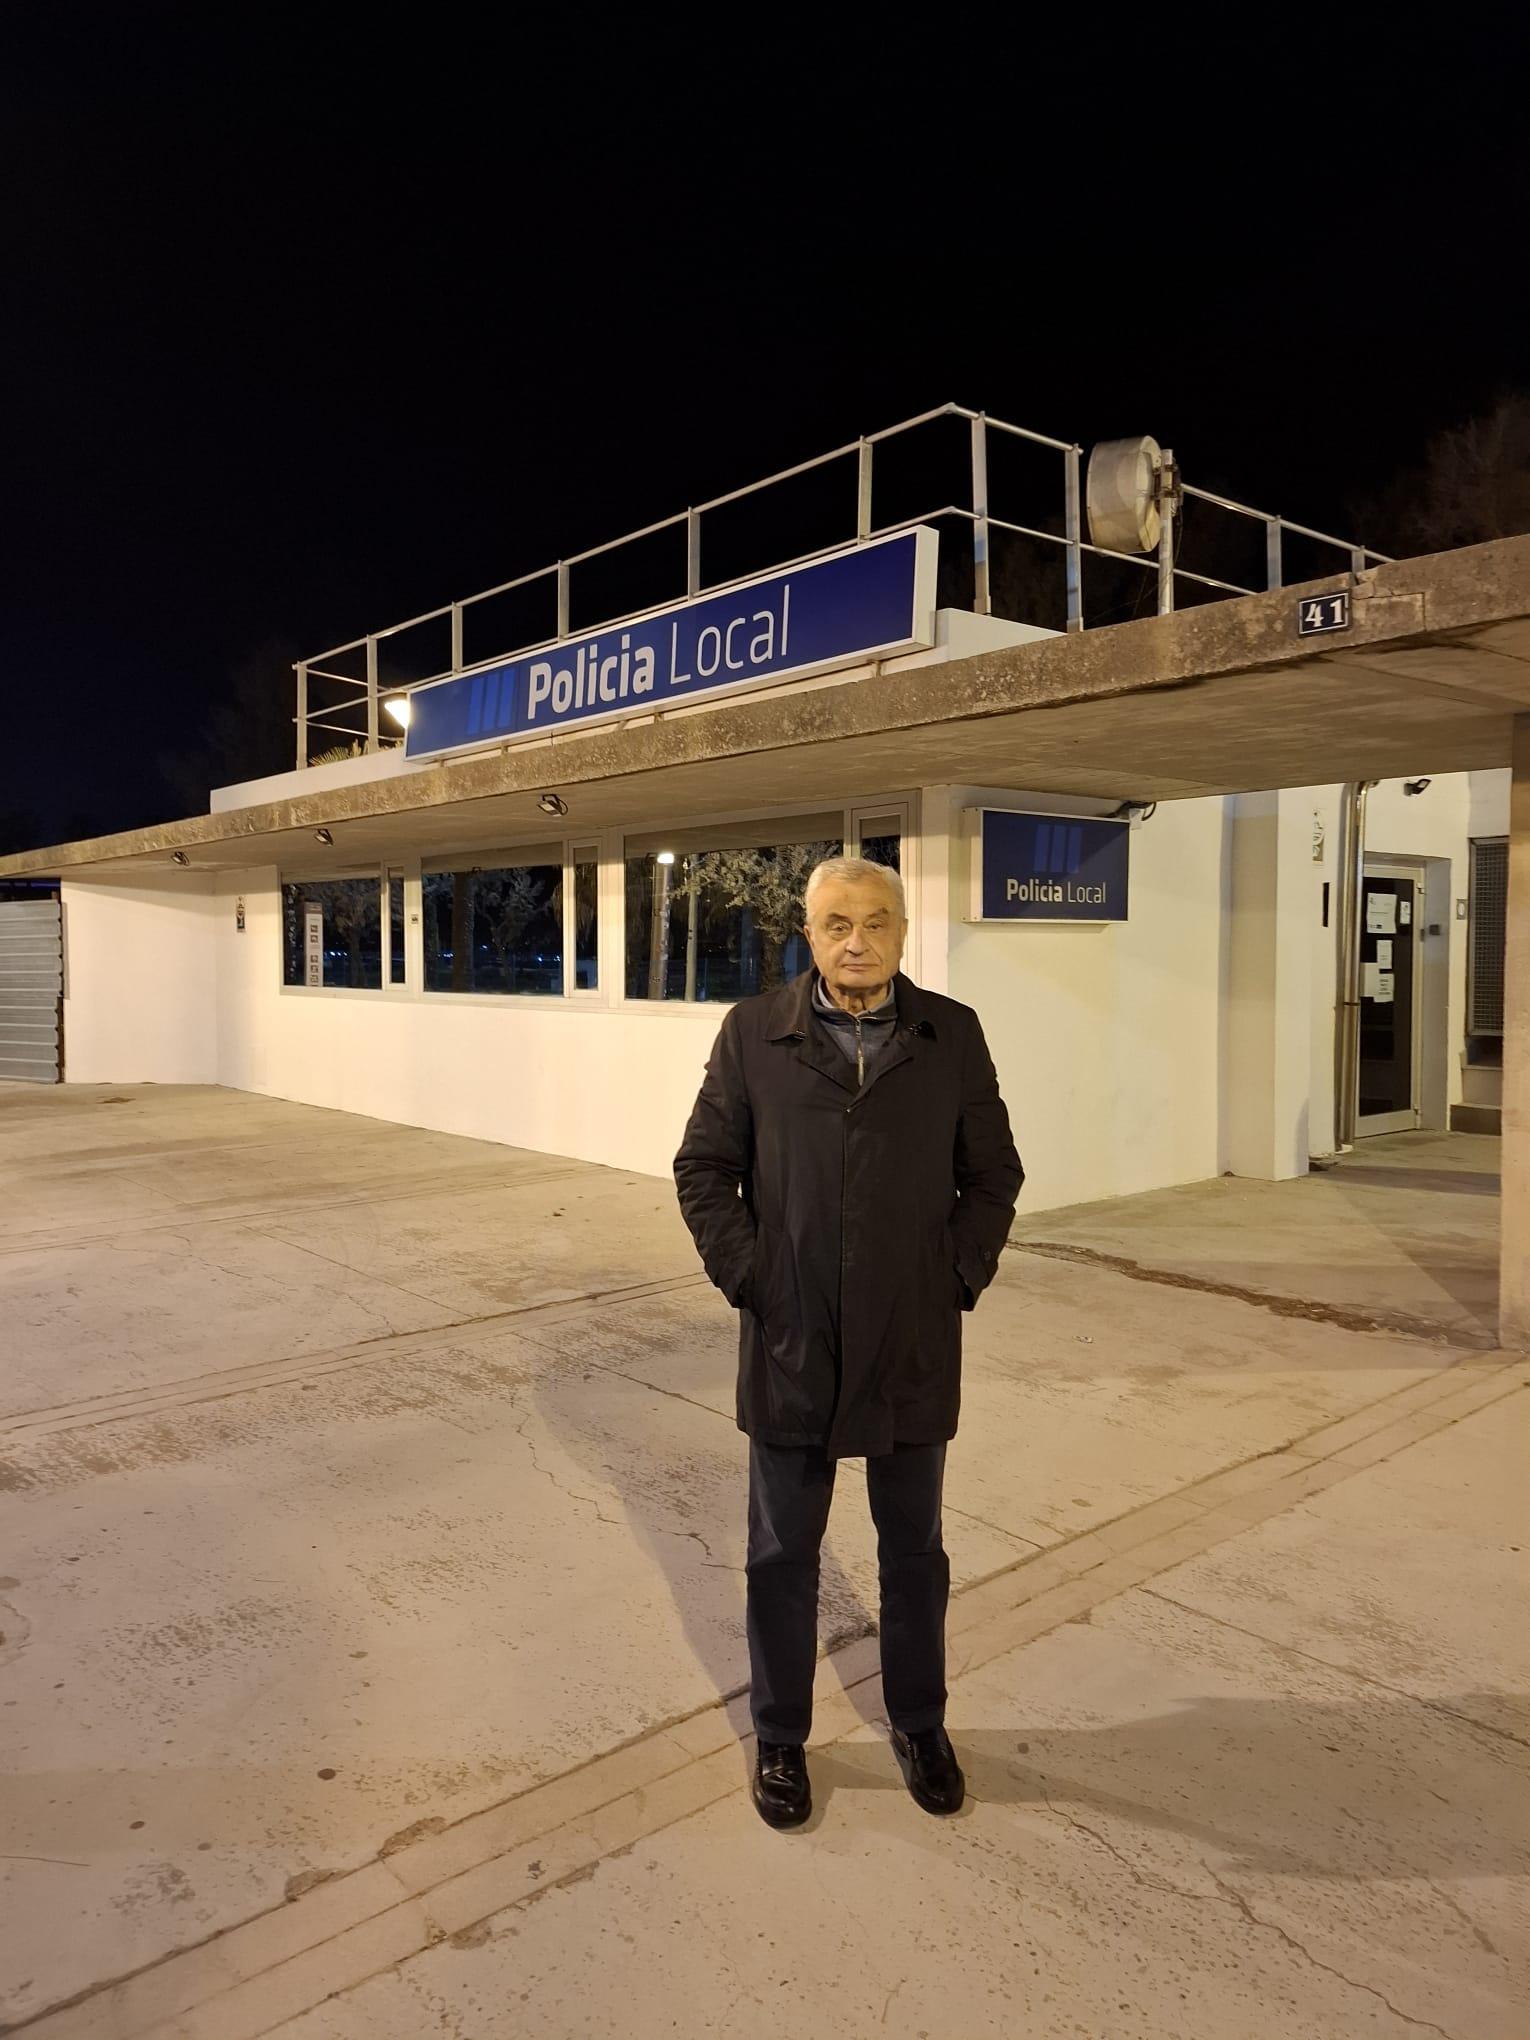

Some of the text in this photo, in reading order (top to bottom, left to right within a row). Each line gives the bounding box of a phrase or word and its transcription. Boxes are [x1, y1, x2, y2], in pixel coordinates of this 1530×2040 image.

[1304, 599, 1344, 627] 41
[527, 584, 790, 720] Policia Local
[1007, 878, 1106, 903] Policia Local
